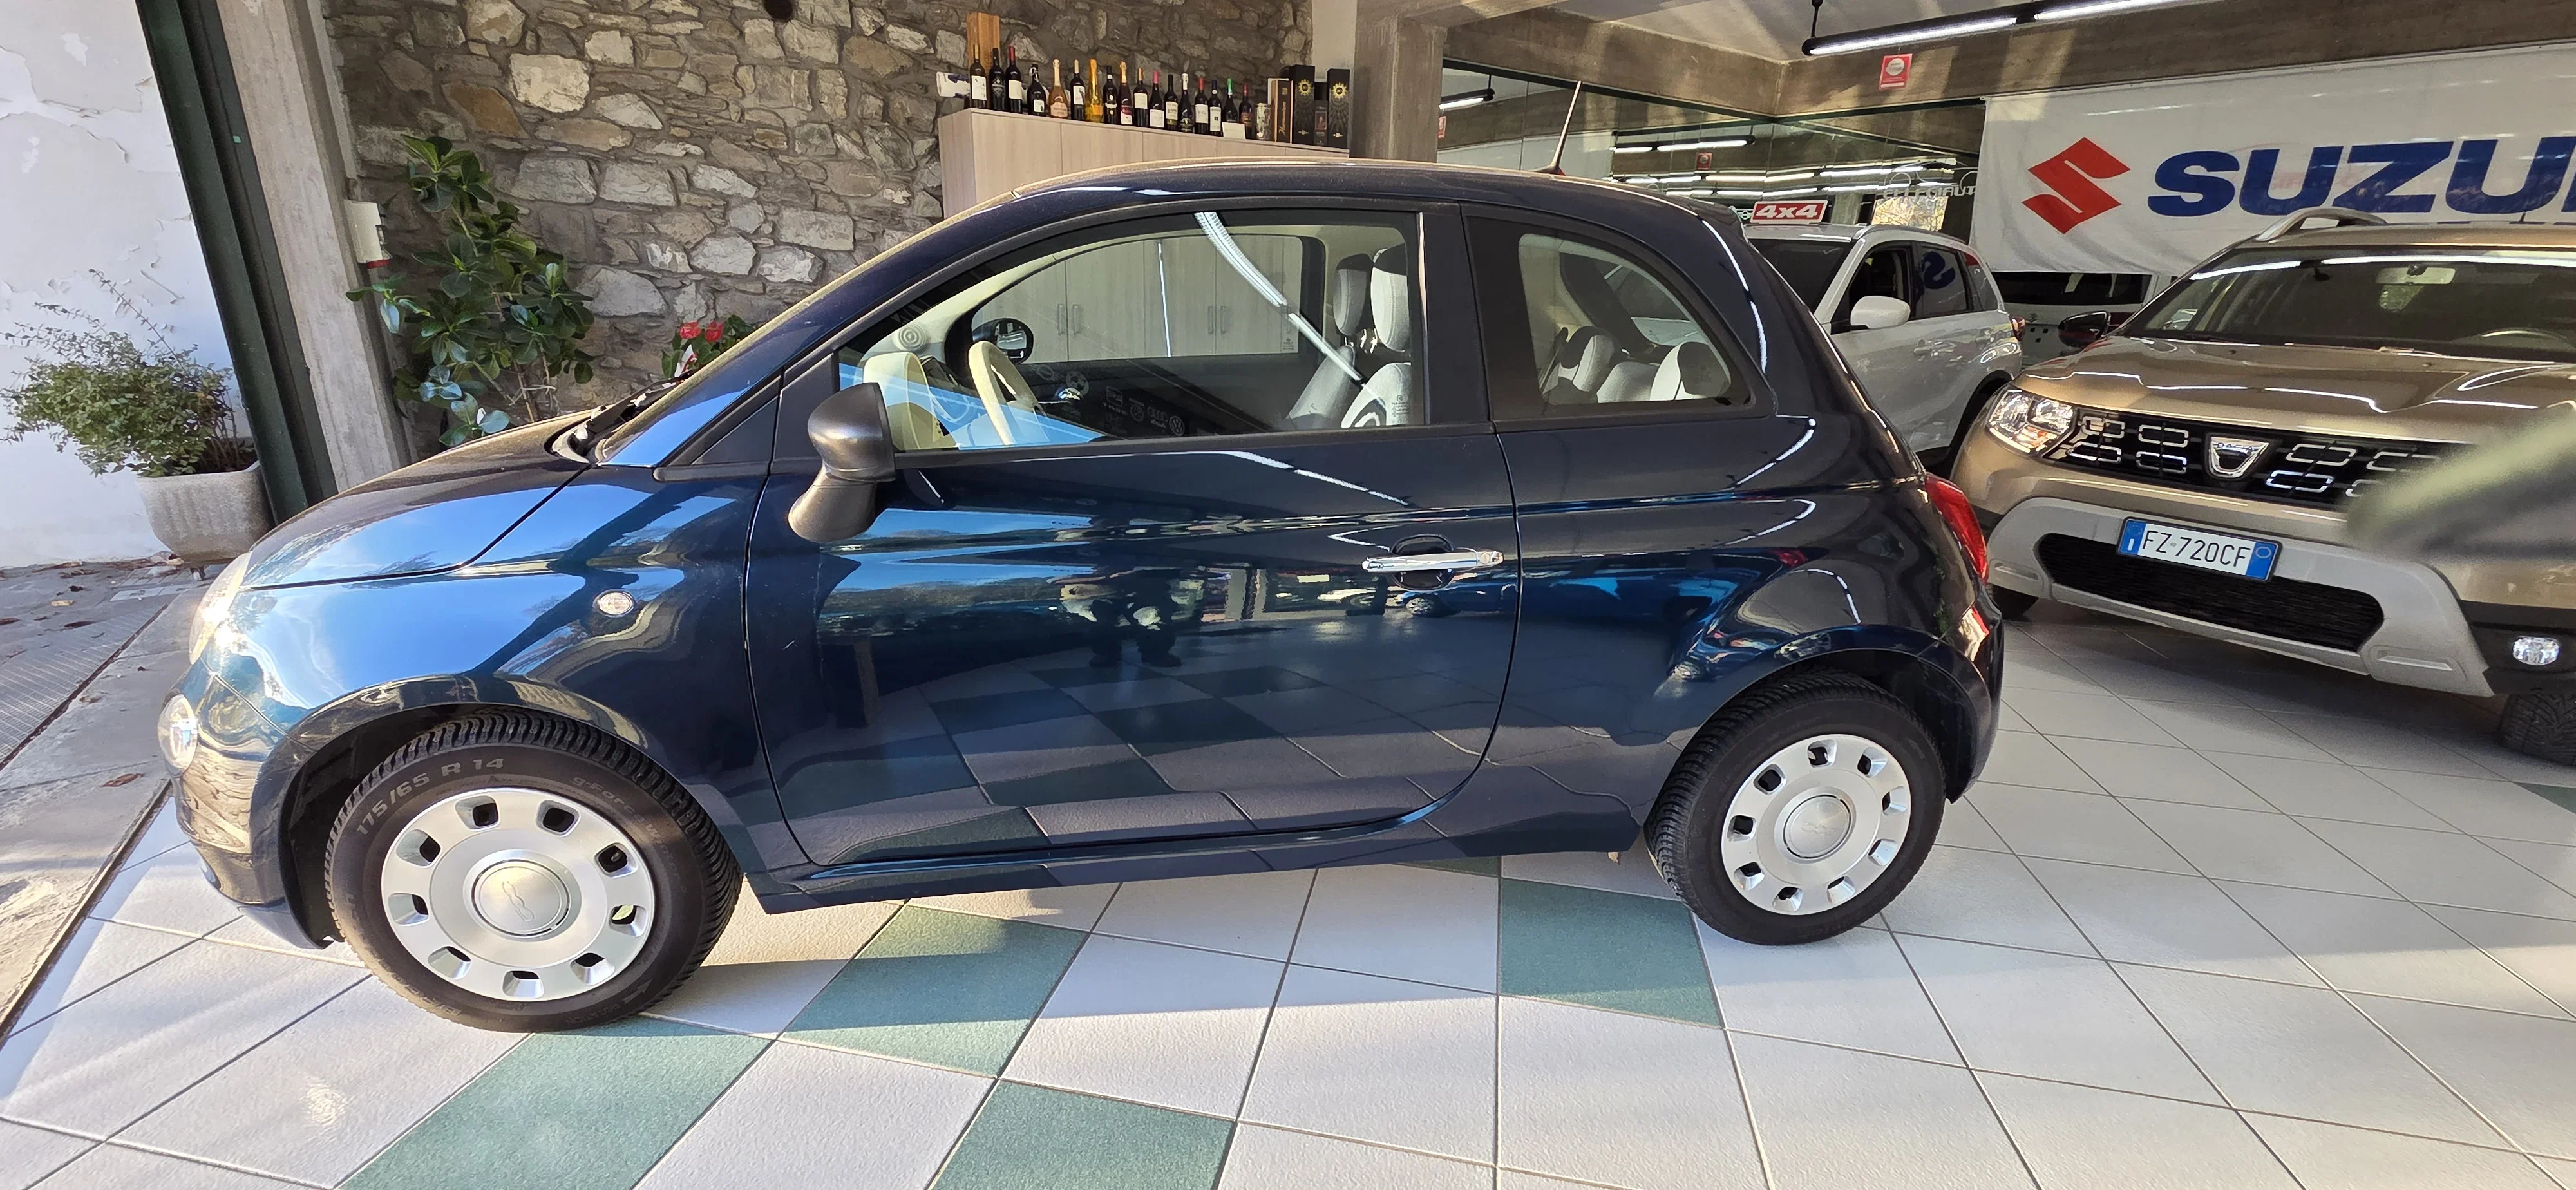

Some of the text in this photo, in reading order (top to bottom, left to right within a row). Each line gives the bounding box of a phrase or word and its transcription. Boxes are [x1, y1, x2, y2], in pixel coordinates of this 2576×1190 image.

[2148, 136, 2576, 217] SUZU
[1756, 205, 1817, 218] 4x4
[2143, 530, 2251, 567] FZ 720CF
[356, 772, 430, 835] 175/65
[441, 762, 461, 777] R
[473, 758, 504, 770] 14
